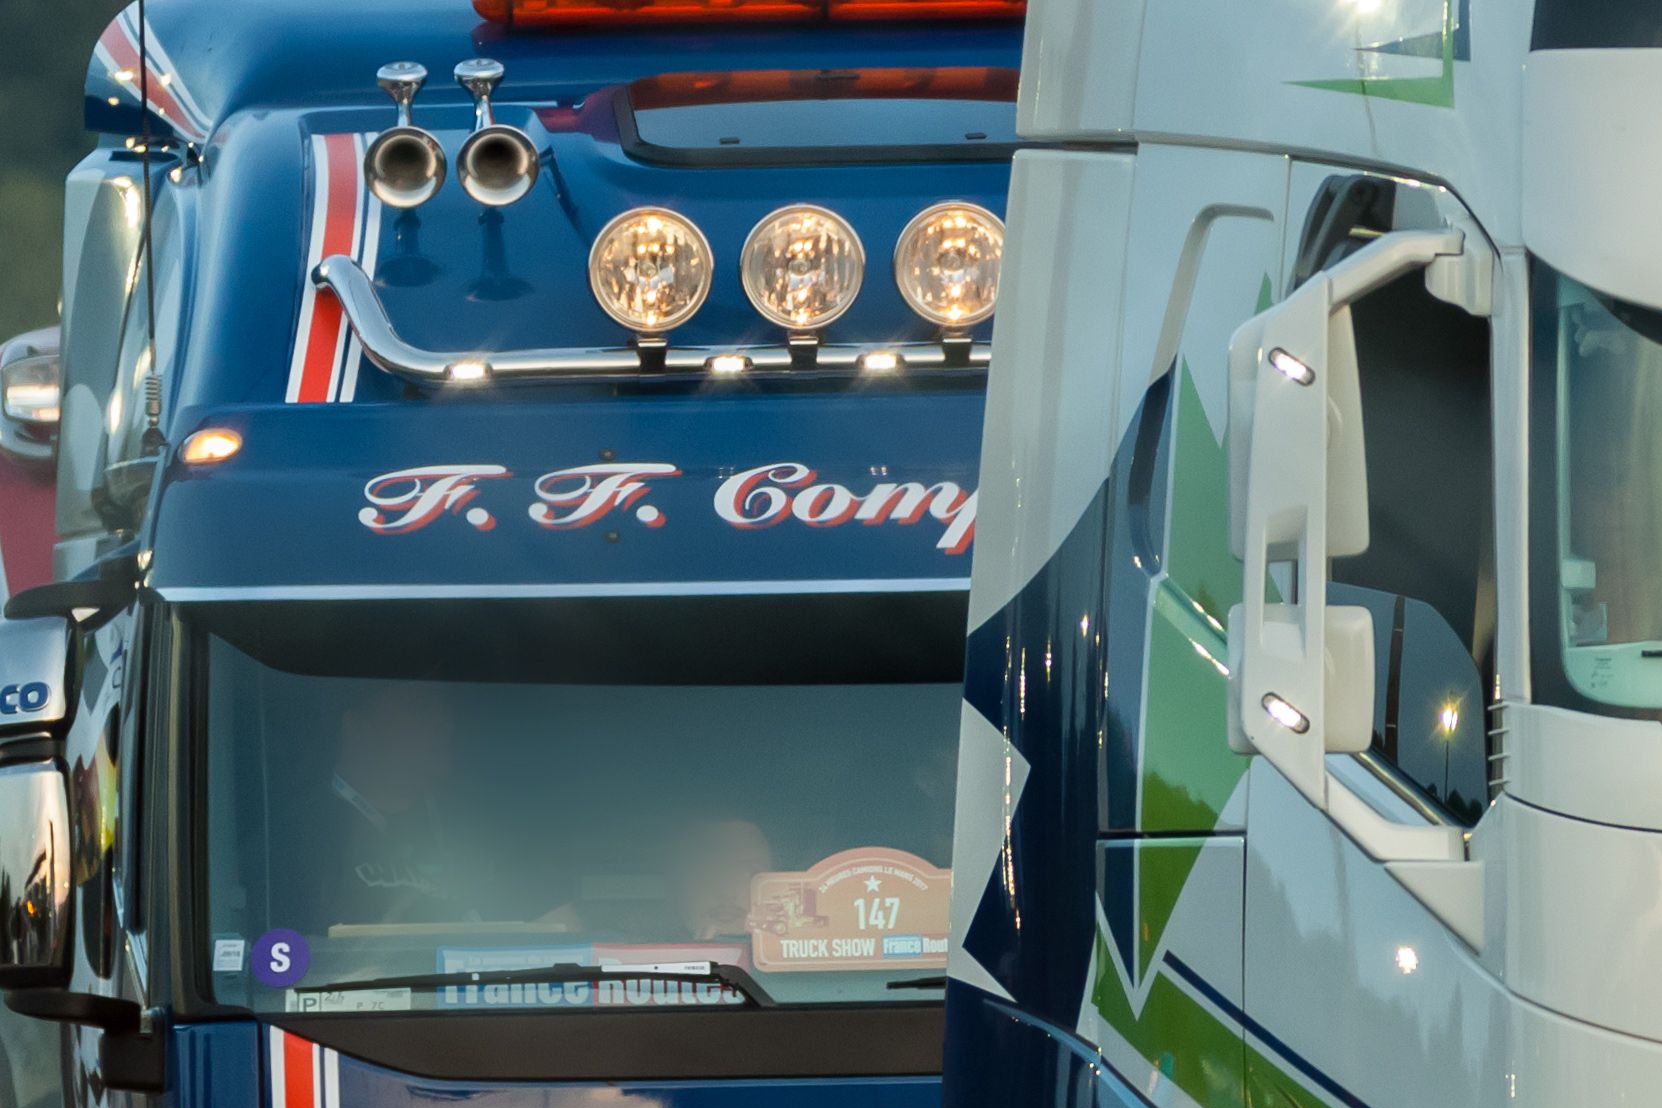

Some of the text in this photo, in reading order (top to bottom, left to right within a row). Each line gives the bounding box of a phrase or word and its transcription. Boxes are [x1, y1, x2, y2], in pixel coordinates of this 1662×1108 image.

[358, 464, 513, 535] F.
[528, 462, 684, 530] F.
[854, 897, 900, 930] 147
[269, 941, 291, 974] S
[780, 939, 827, 958] TRUCK
[832, 938, 875, 957] SHOW
